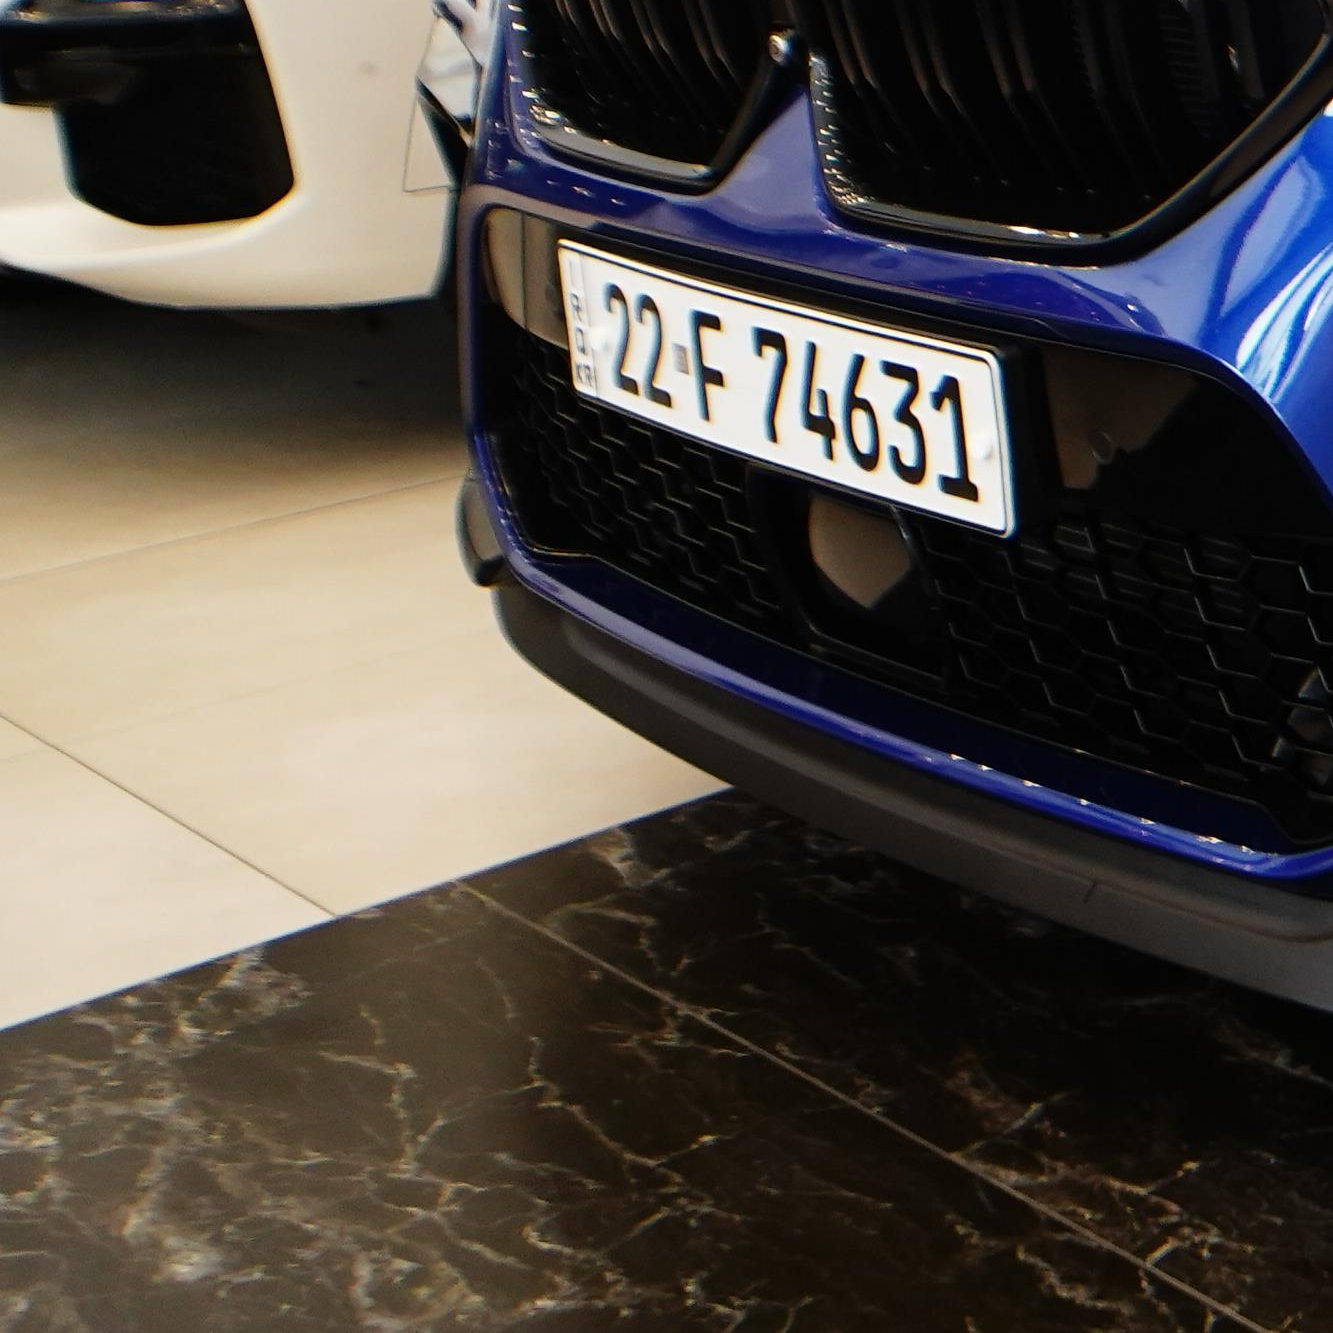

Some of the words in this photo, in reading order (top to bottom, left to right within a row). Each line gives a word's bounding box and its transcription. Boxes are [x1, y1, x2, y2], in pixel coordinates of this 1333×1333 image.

[602, 282, 672, 408] 22
[689, 308, 725, 423] F
[752, 326, 979, 503] 74631
